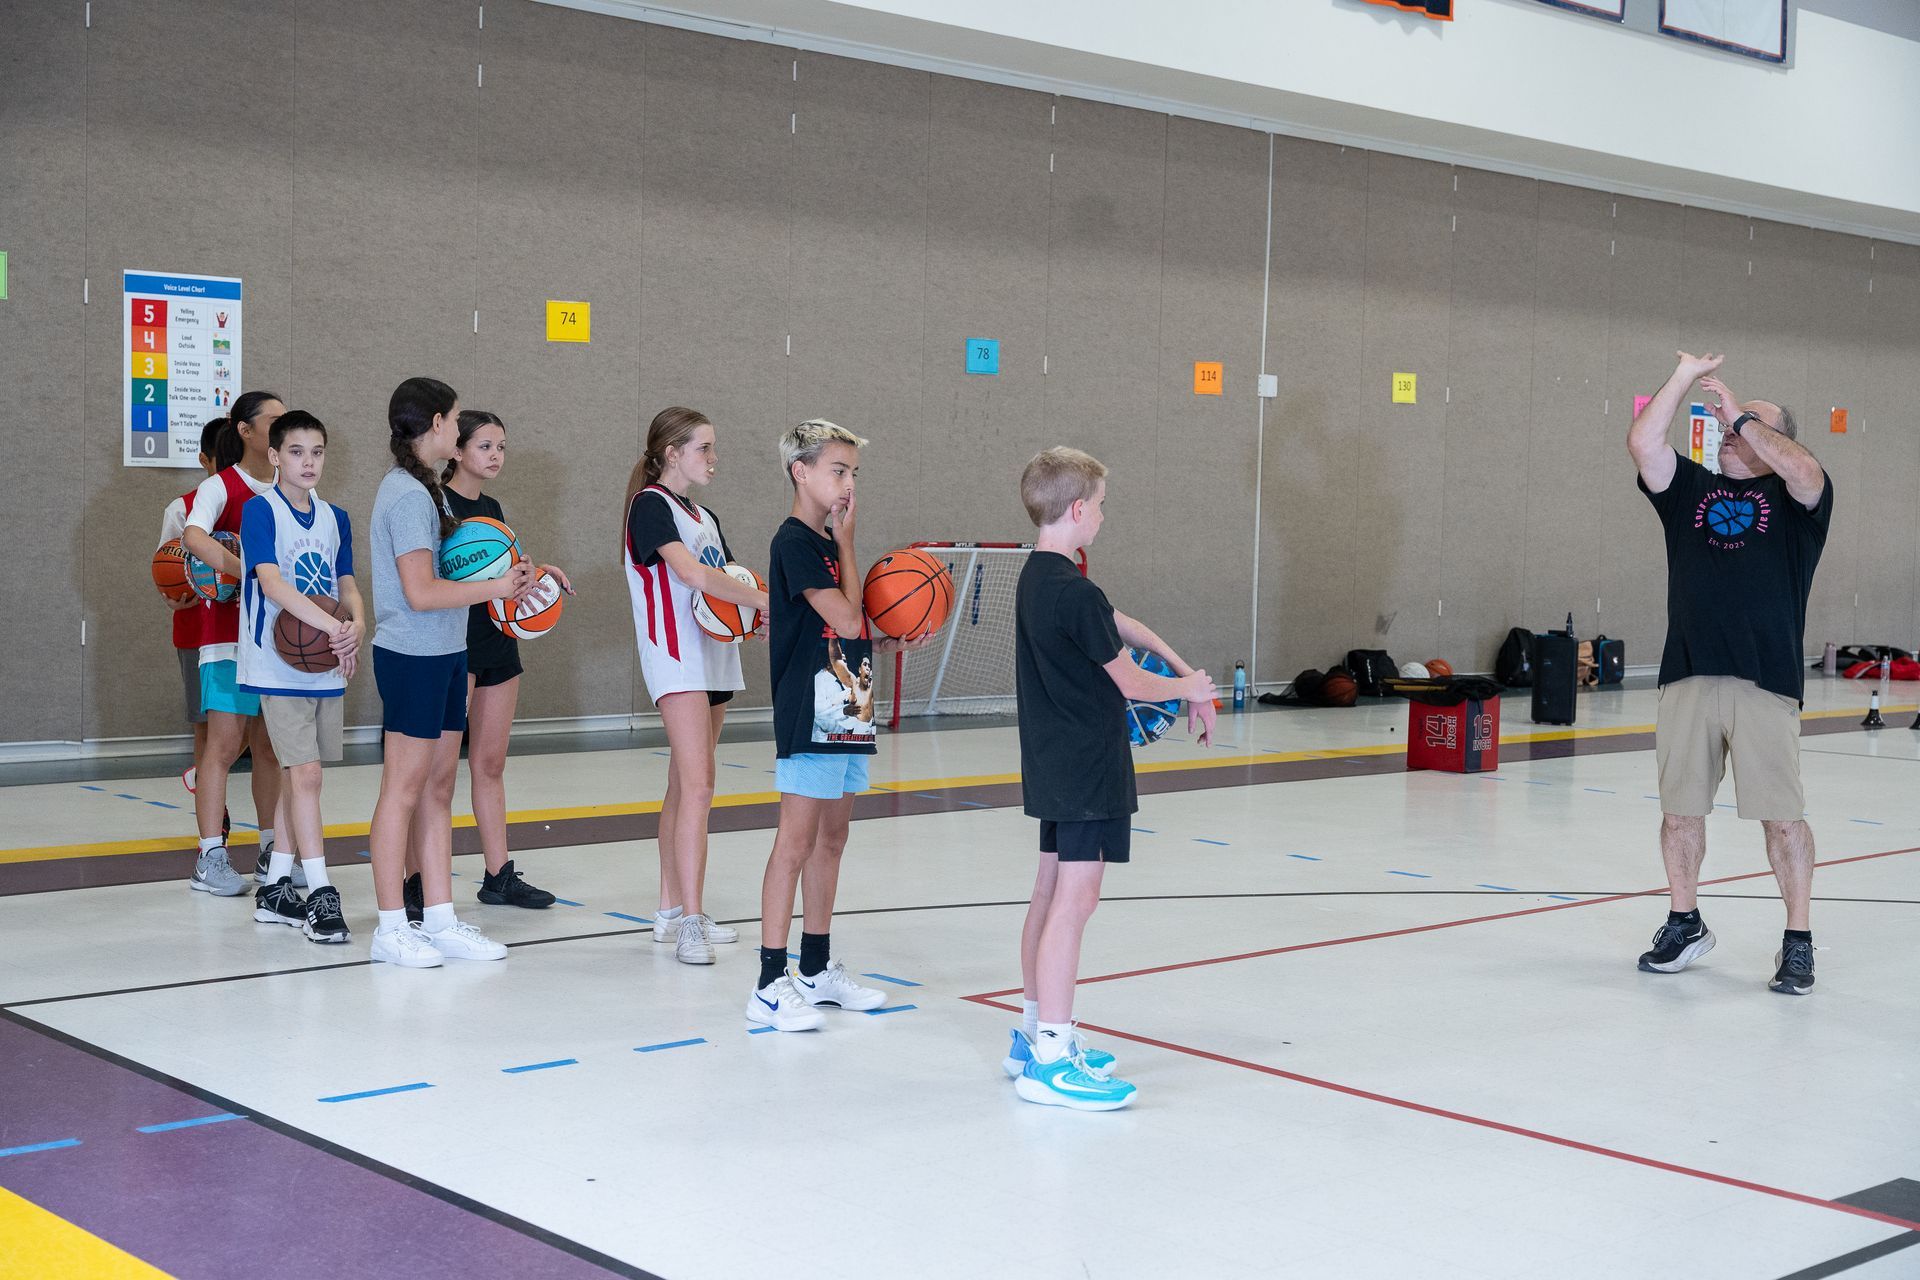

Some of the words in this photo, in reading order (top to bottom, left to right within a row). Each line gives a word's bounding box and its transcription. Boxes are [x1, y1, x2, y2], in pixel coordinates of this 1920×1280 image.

[163, 283, 178, 292] Voice
[178, 285, 191, 293] Level
[191, 286, 206, 294] Chart
[144, 304, 155, 323] 5
[175, 316, 200, 325] Emergency
[180, 308, 195, 316] Yelling
[560, 311, 577, 326] 74
[144, 331, 155, 350] 4
[976, 347, 990, 360] 78
[144, 357, 155, 376] 3
[1201, 370, 1217, 381] 114
[144, 384, 155, 402] 2
[1398, 380, 1411, 391] 130
[147, 410, 153, 428] 1
[144, 436, 156, 455] 0
[441, 548, 490, 578] Wilson
[1426, 714, 1447, 748] 14
[1446, 716, 1458, 750] INCH
[1473, 713, 1493, 740] 16
[1473, 738, 1492, 751] INCH
